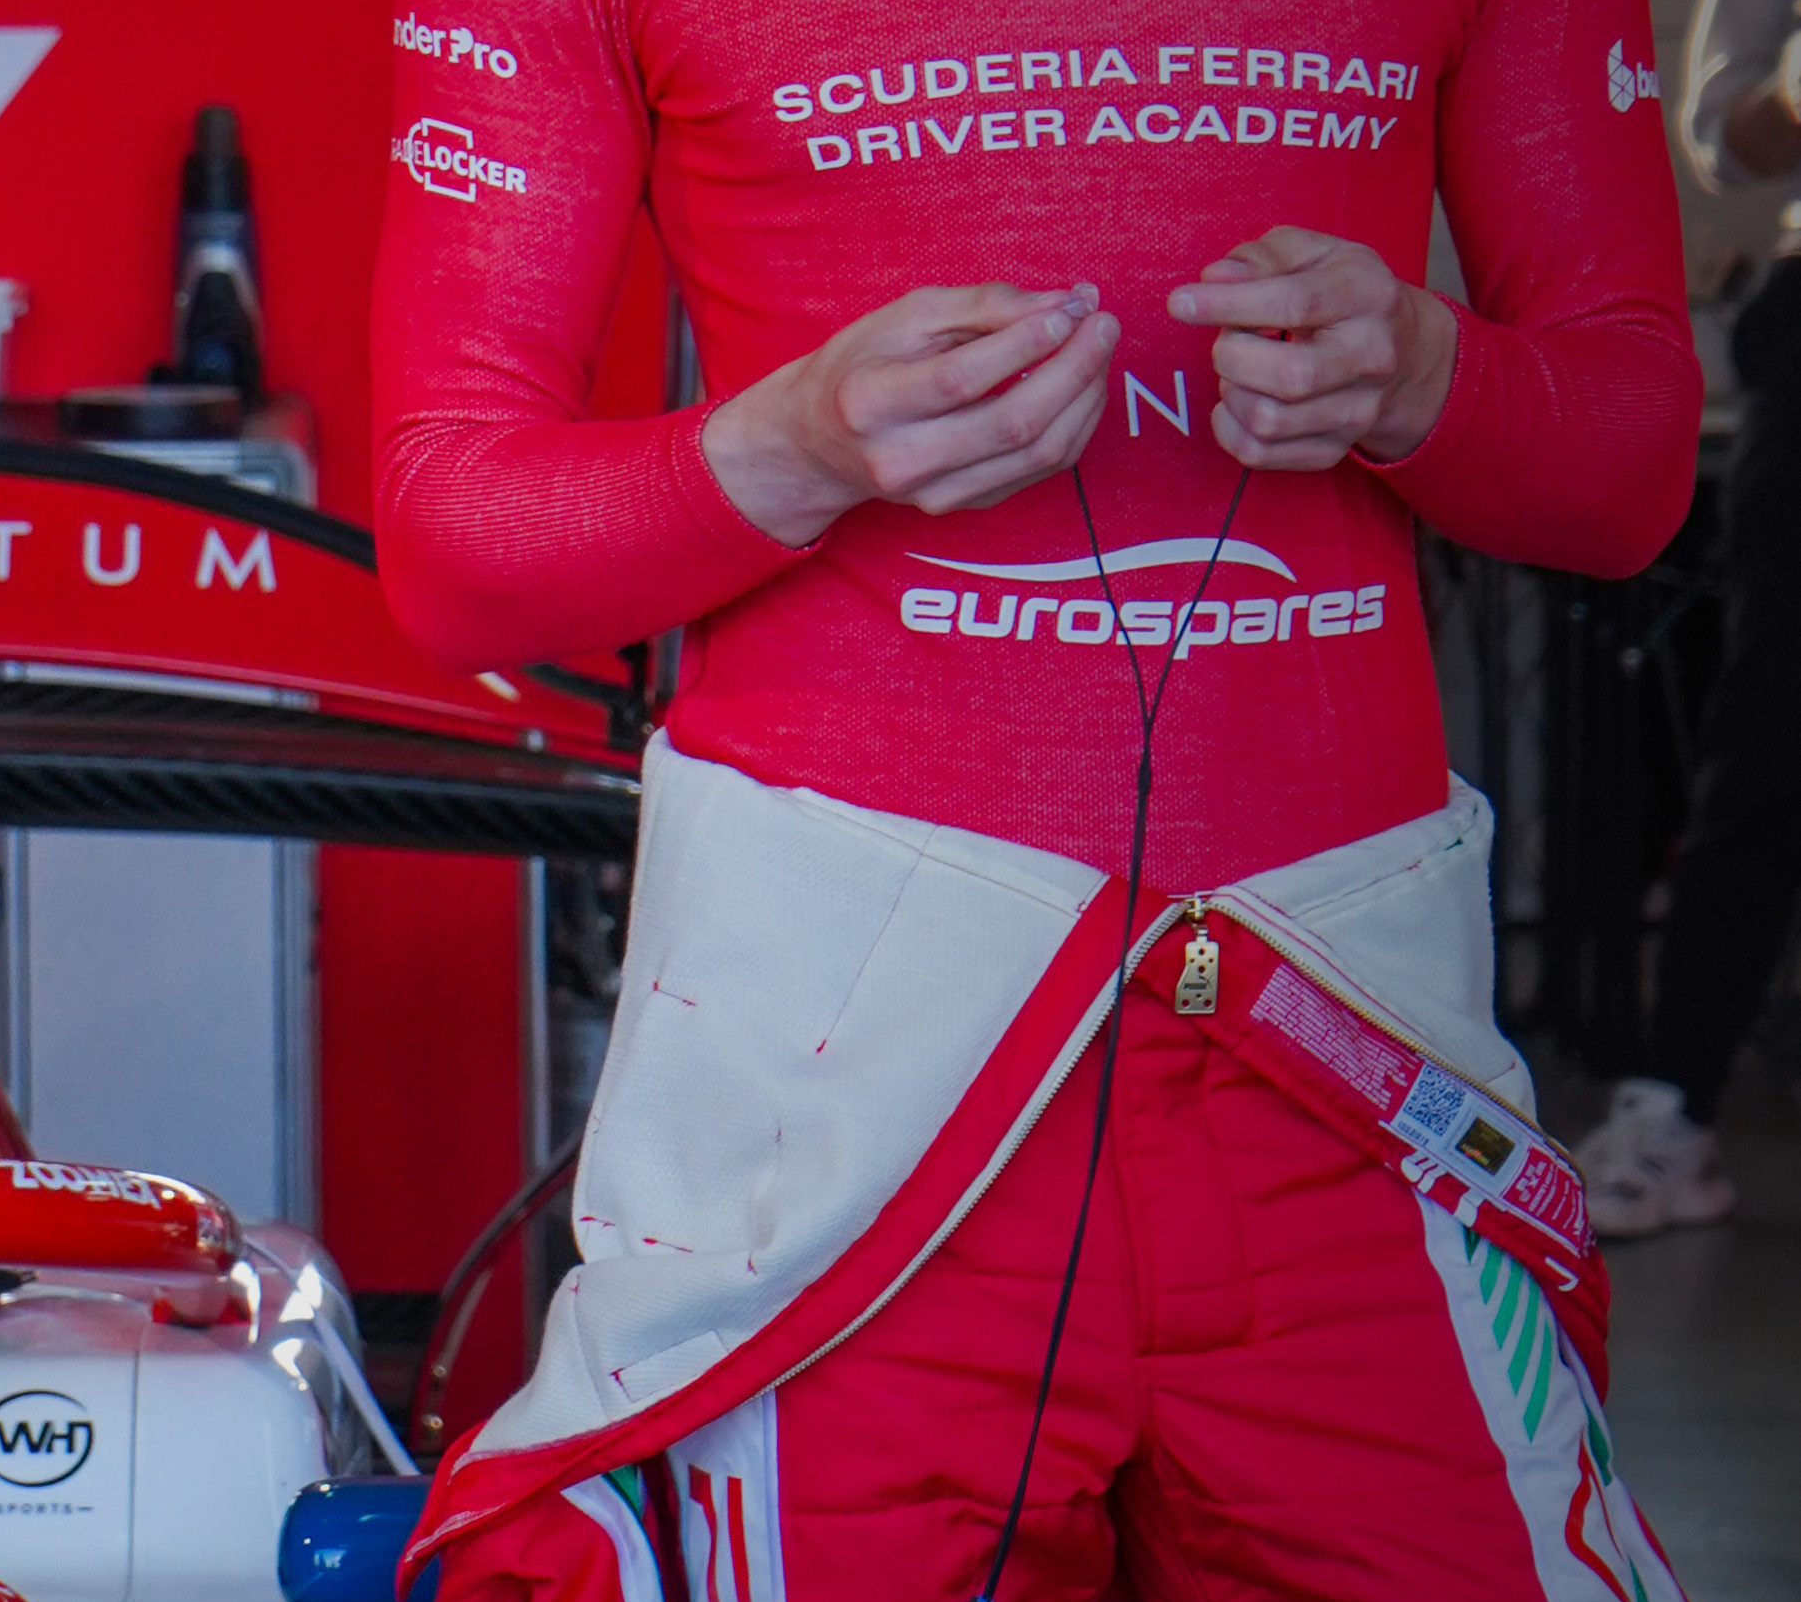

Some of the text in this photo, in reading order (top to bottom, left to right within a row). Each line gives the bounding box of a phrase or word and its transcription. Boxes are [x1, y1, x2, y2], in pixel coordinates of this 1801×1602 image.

[772, 45, 1420, 123] SCUDERIA FERRARI
[806, 103, 1398, 172] DRIVER ACADEMY
[899, 584, 1387, 661] eurospares
